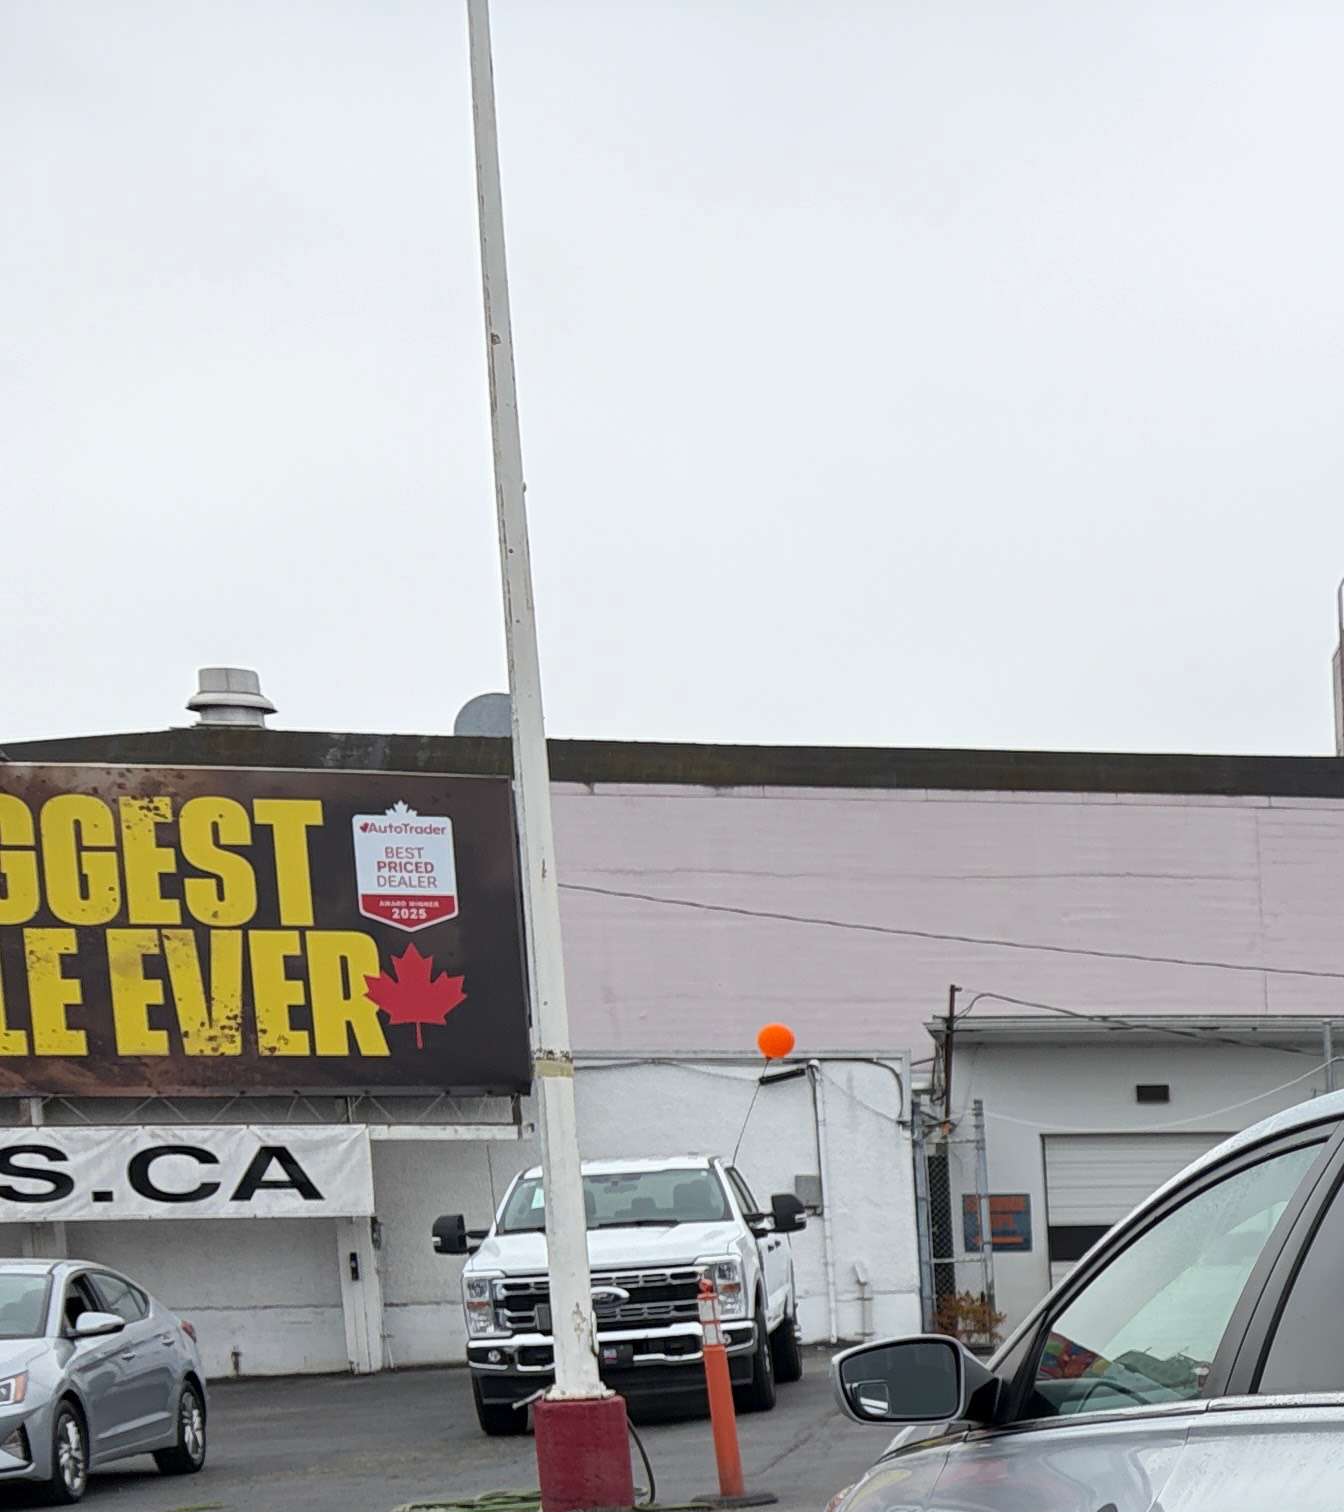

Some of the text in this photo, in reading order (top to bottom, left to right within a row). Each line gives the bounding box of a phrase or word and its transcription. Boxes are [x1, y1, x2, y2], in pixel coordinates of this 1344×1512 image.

[368, 822, 446, 835] AutoTrader
[385, 846, 424, 859] BEST
[377, 861, 434, 873] PRICED
[377, 875, 438, 889] DEALER
[392, 908, 427, 919] 2025
[106, 928, 391, 1057] EVER
